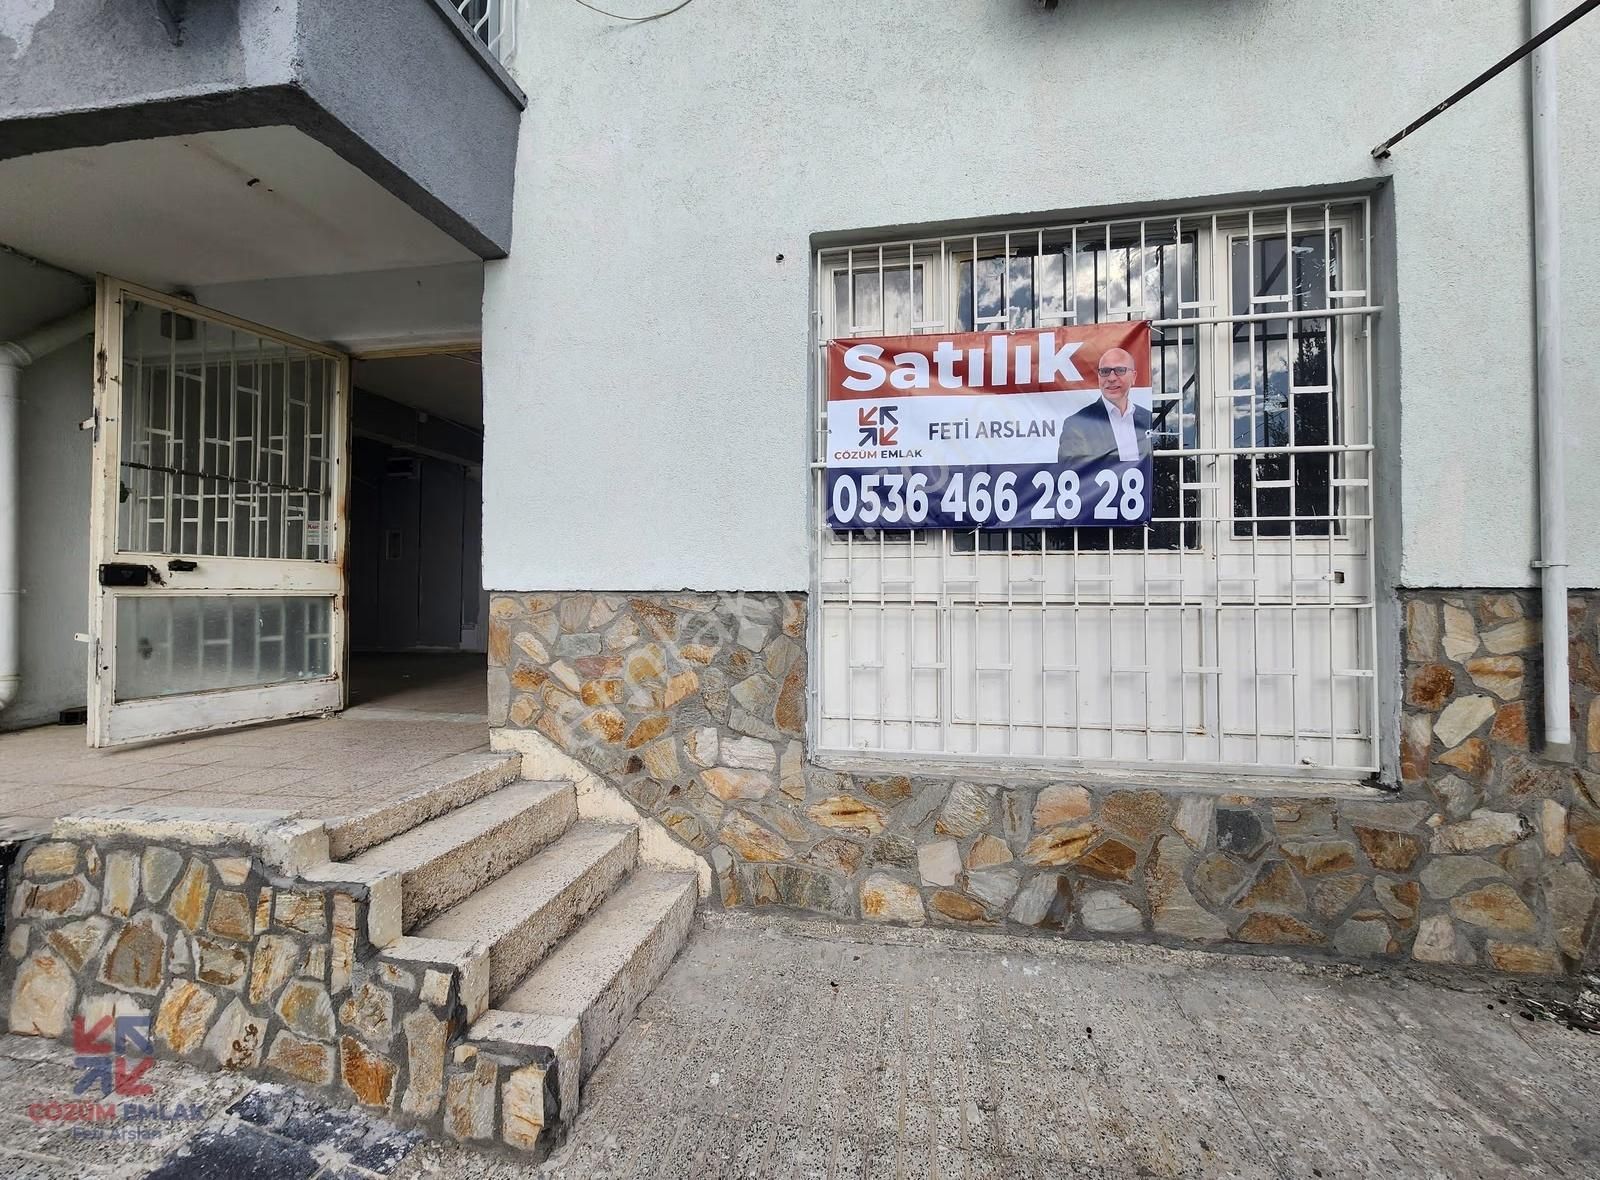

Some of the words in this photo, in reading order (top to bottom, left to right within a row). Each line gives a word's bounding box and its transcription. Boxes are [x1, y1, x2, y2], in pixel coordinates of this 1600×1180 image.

[841, 331, 1085, 392] Satılık
[928, 417, 969, 441] FETİ
[975, 419, 1056, 439] ARSLAN
[834, 450, 877, 461] ÇÖZÜM
[880, 449, 923, 459] EMLAK
[832, 473, 929, 524] 0536
[940, 470, 1018, 522] 466
[1030, 469, 1082, 520] 28
[1094, 467, 1145, 520] 28
